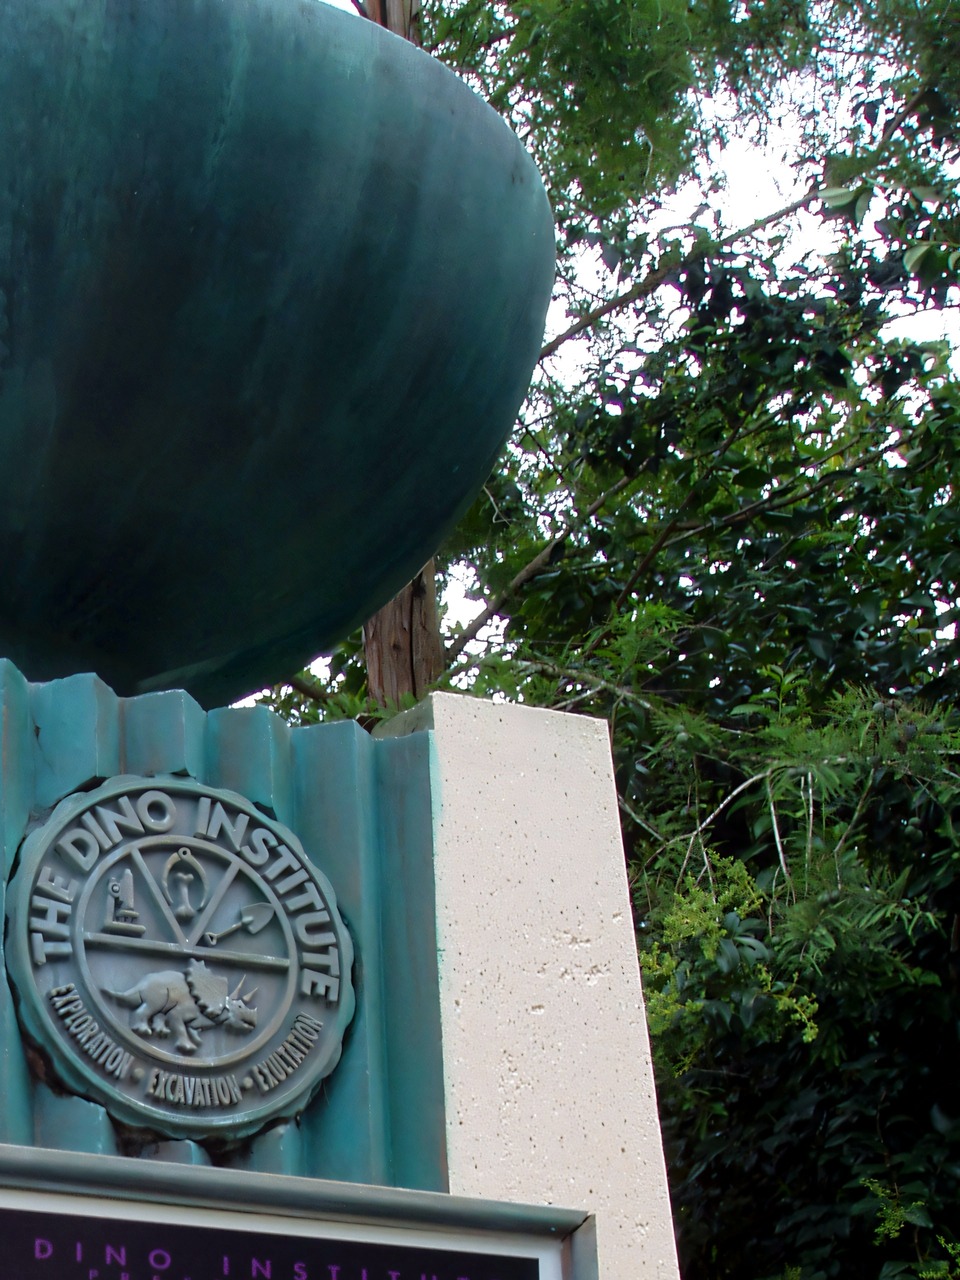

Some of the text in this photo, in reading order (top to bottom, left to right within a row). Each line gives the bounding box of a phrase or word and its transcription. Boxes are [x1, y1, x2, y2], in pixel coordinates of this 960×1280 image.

[29, 789, 341, 1002] THE DINO INSTITUTE
[49, 983, 324, 1107] EXPLORATION EXCAVATION EXULTATION
[34, 1238, 172, 1270] DINO
